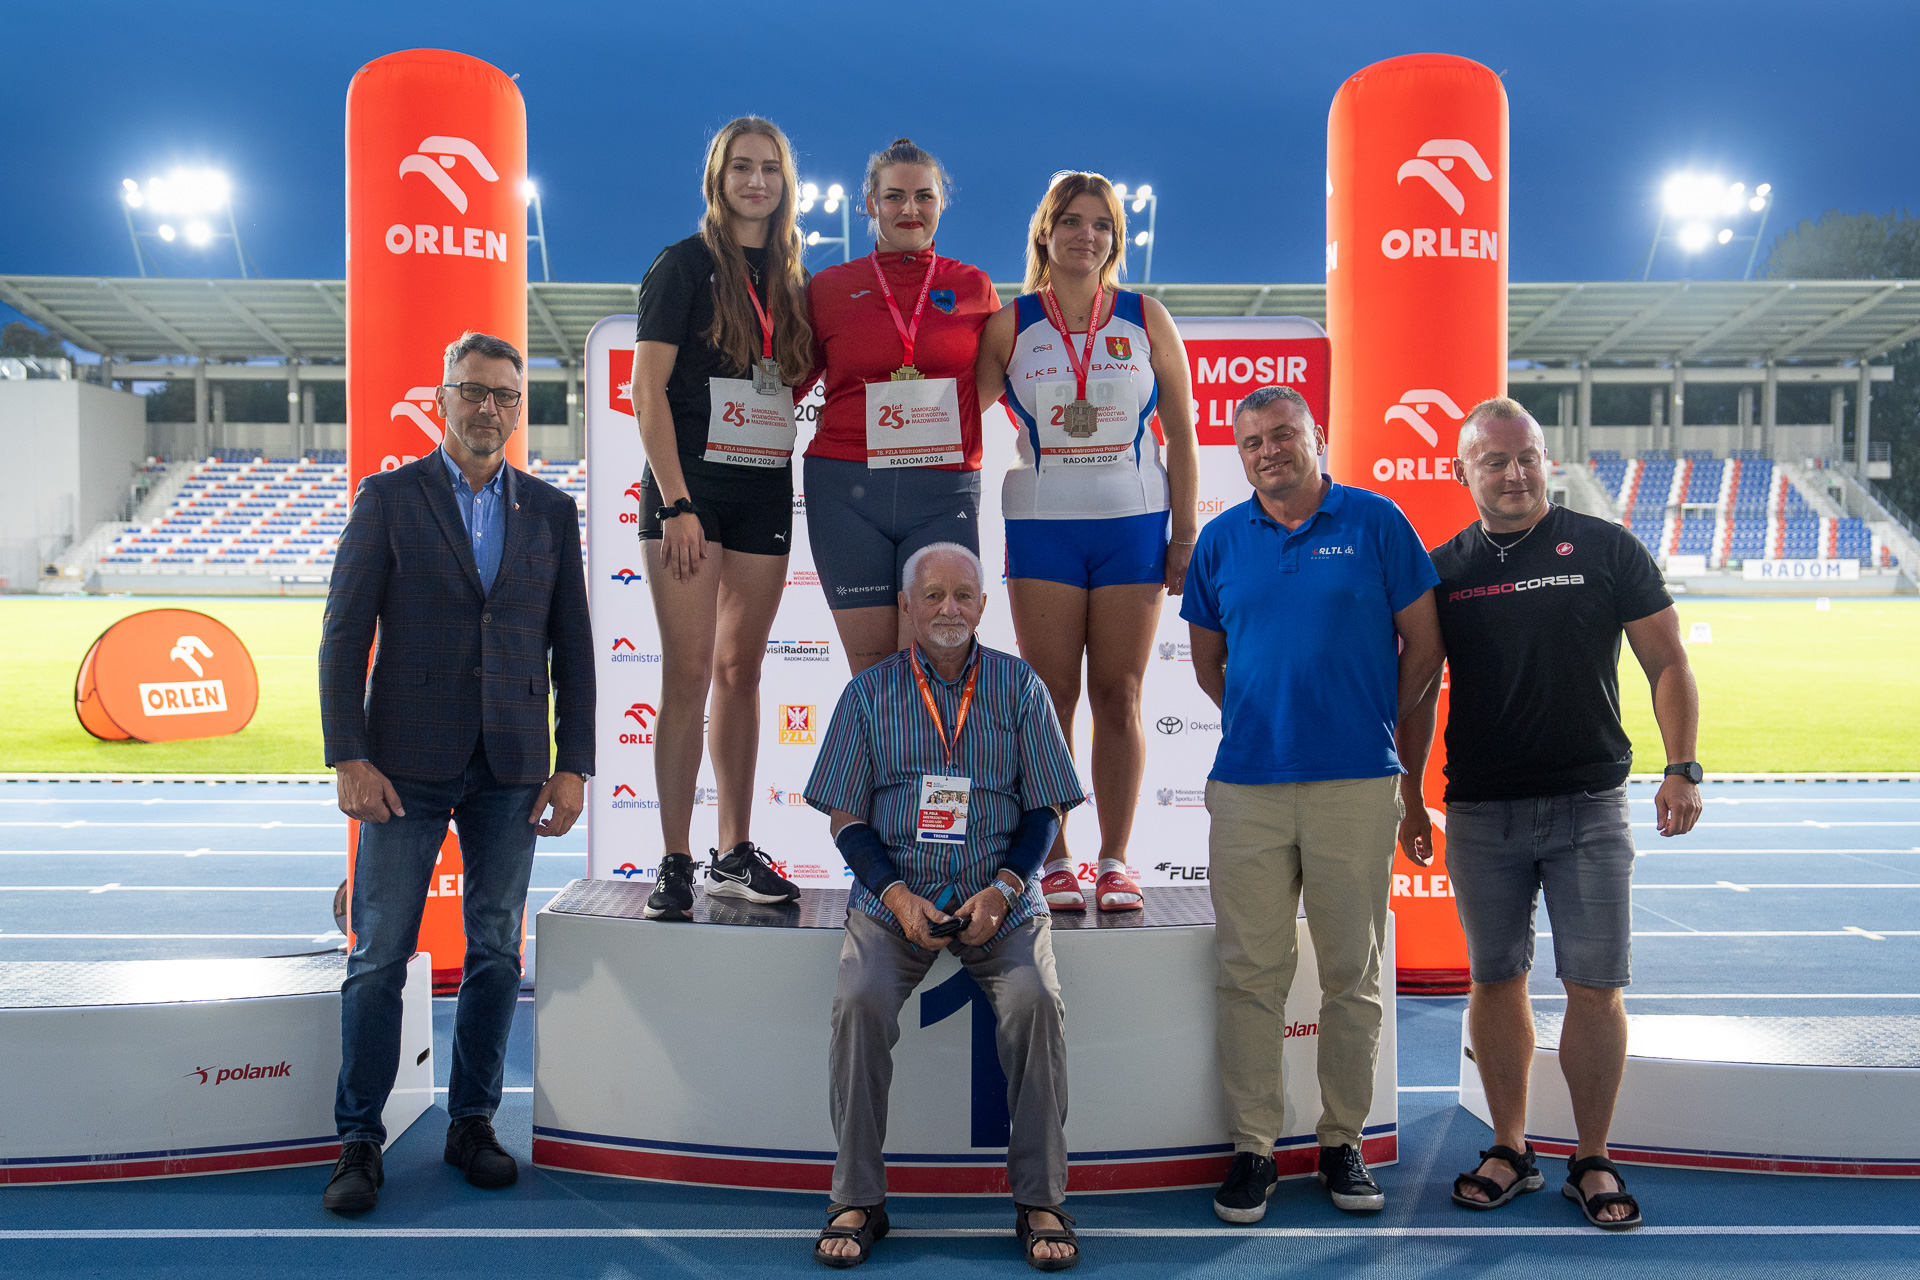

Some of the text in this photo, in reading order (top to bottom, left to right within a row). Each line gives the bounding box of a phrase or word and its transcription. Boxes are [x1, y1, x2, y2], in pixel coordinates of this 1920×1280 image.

[385, 223, 507, 263] ORLEN
[1381, 227, 1498, 261] ORLEN
[1086, 335, 1094, 349] 2024
[1025, 363, 1140, 379] LKS LBAWA
[1197, 356, 1308, 384] MOSIR
[1097, 410, 1126, 418] WÓDZTWA
[1096, 416, 1128, 424] OWIECKIEGO
[736, 446, 765, 455] Mistrzostwa
[899, 447, 931, 455] Mistrzostwa
[726, 455, 776, 466] RADOM 2024
[890, 455, 944, 466] RADOM 2024
[1097, 455, 1118, 463] 2024
[1198, 497, 1225, 512] osir
[1319, 546, 1343, 555] RLTL
[1761, 563, 1841, 577] RADOM
[848, 585, 890, 593] HENSFORT
[766, 645, 830, 656] visitRadom.pl
[611, 652, 662, 663] administrat
[147, 686, 220, 710] ORLEN
[1190, 721, 1221, 732] Okęcie
[619, 733, 653, 744] ORLE
[781, 731, 814, 743] PZLA
[612, 799, 660, 809] administra
[1170, 866, 1209, 880] FUE
[1392, 874, 1456, 898] RLE
[1283, 1020, 1319, 1039] olan
[920, 966, 1011, 1148] 1
[215, 1061, 292, 1085] polanik
